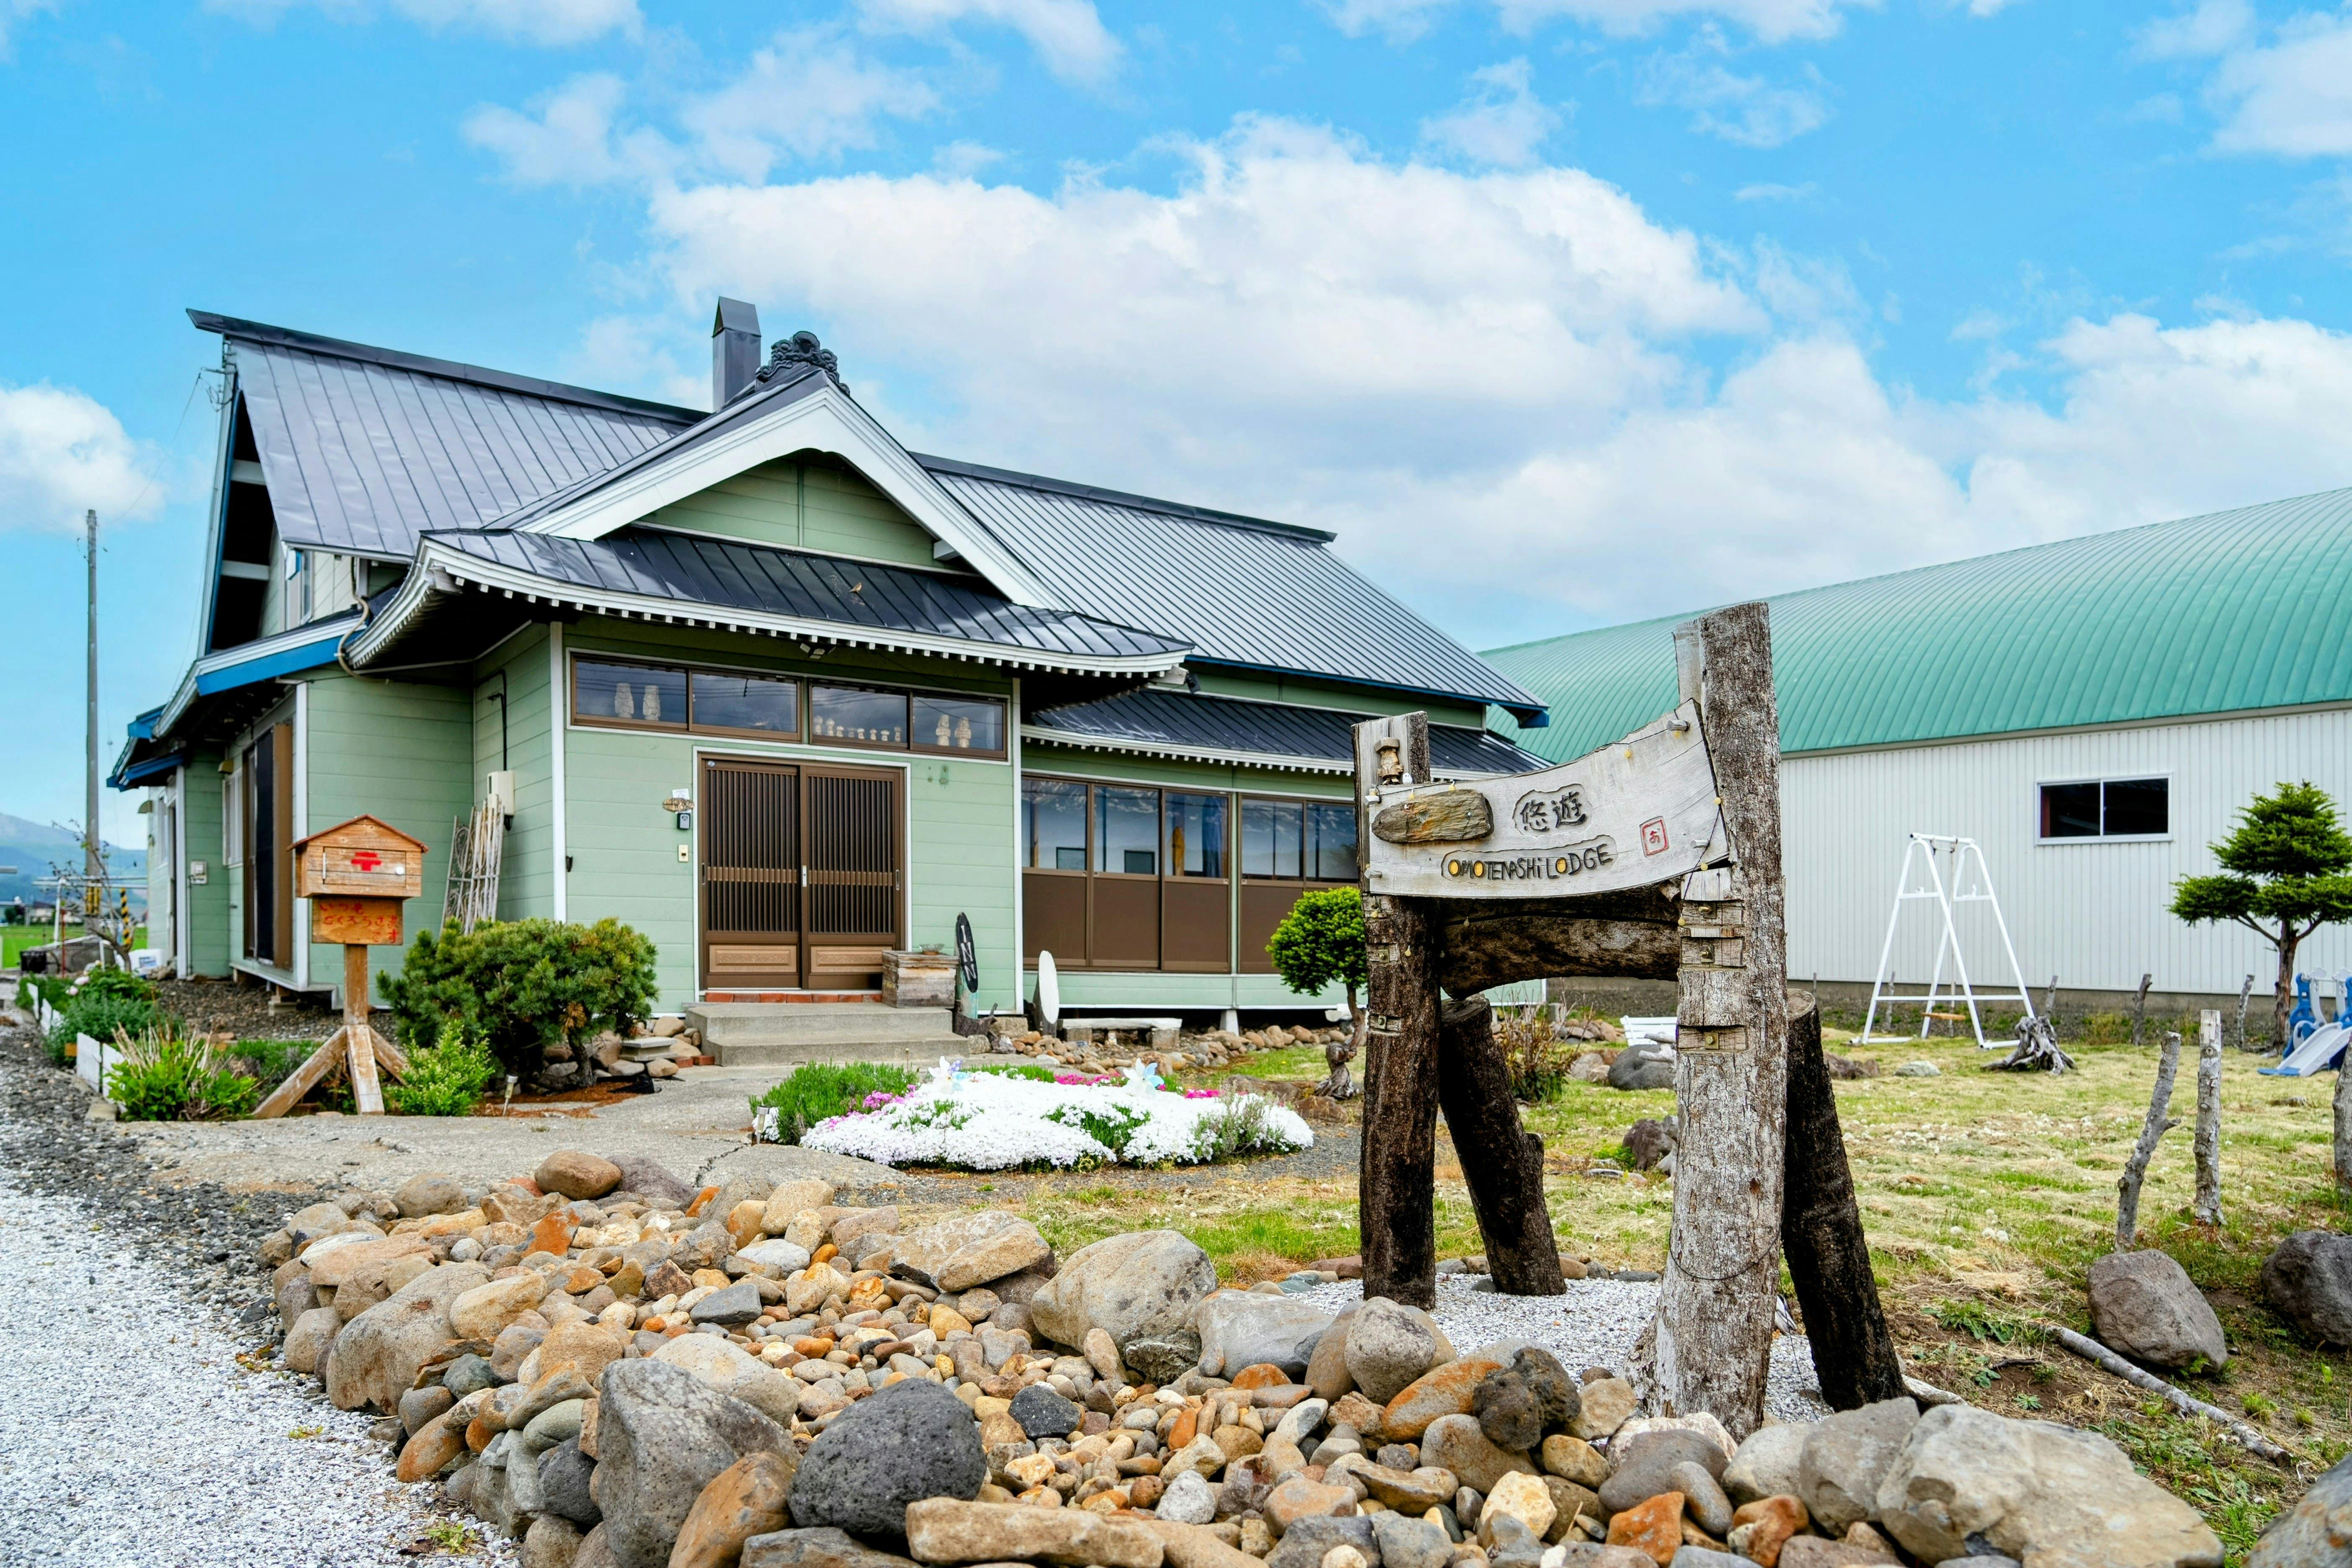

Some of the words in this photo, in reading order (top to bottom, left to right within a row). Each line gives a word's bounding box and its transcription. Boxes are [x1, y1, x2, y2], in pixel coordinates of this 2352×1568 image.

[1519, 790, 1588, 831] 悠遊
[1546, 843, 1613, 879] LODGE
[320, 903, 364, 915] いつも
[960, 925, 977, 981] INN
